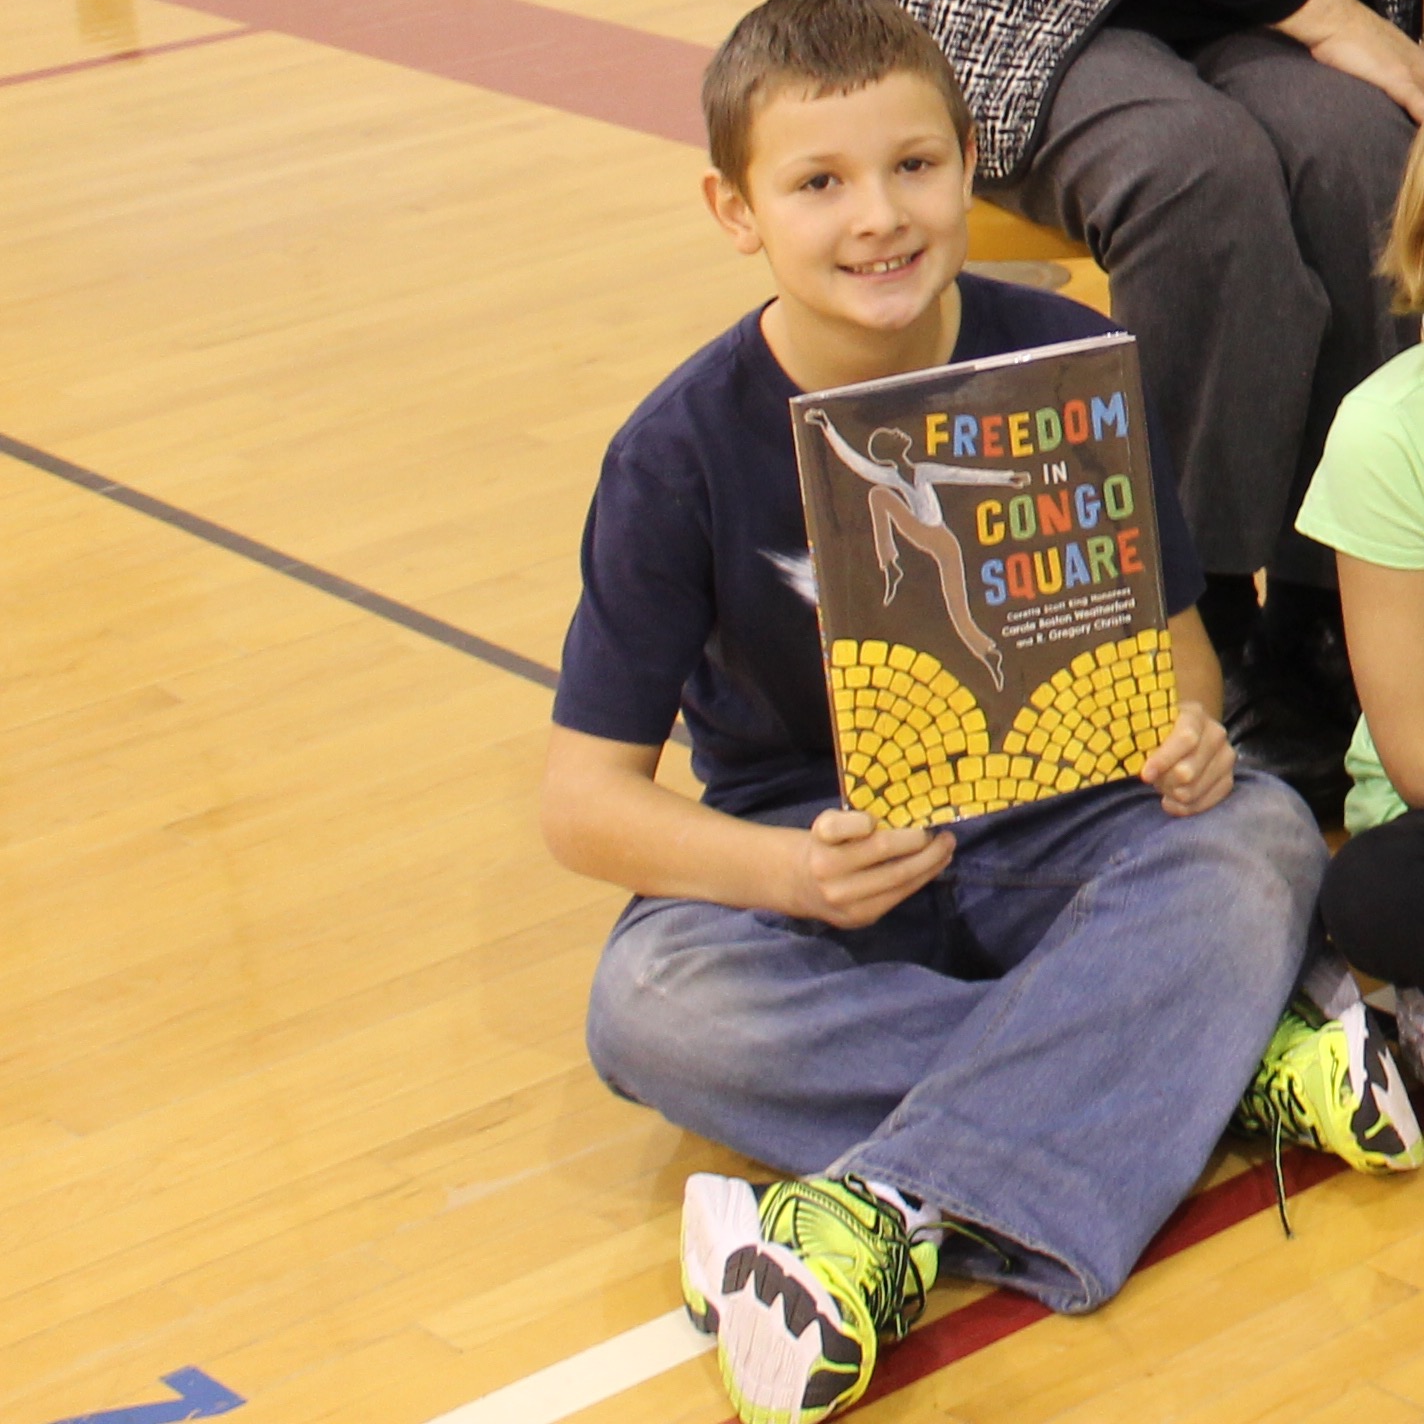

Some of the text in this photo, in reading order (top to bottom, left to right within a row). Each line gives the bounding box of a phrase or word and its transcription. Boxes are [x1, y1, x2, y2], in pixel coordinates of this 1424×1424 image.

[925, 391, 1128, 458] FREEDOM
[1042, 460, 1068, 485] IN
[975, 473, 1135, 546] CONGO
[980, 527, 1145, 607] SQUARE
[1038, 613, 1073, 629] Boston
[1074, 597, 1136, 621] Weatherford
[1048, 622, 1092, 641] Gregory
